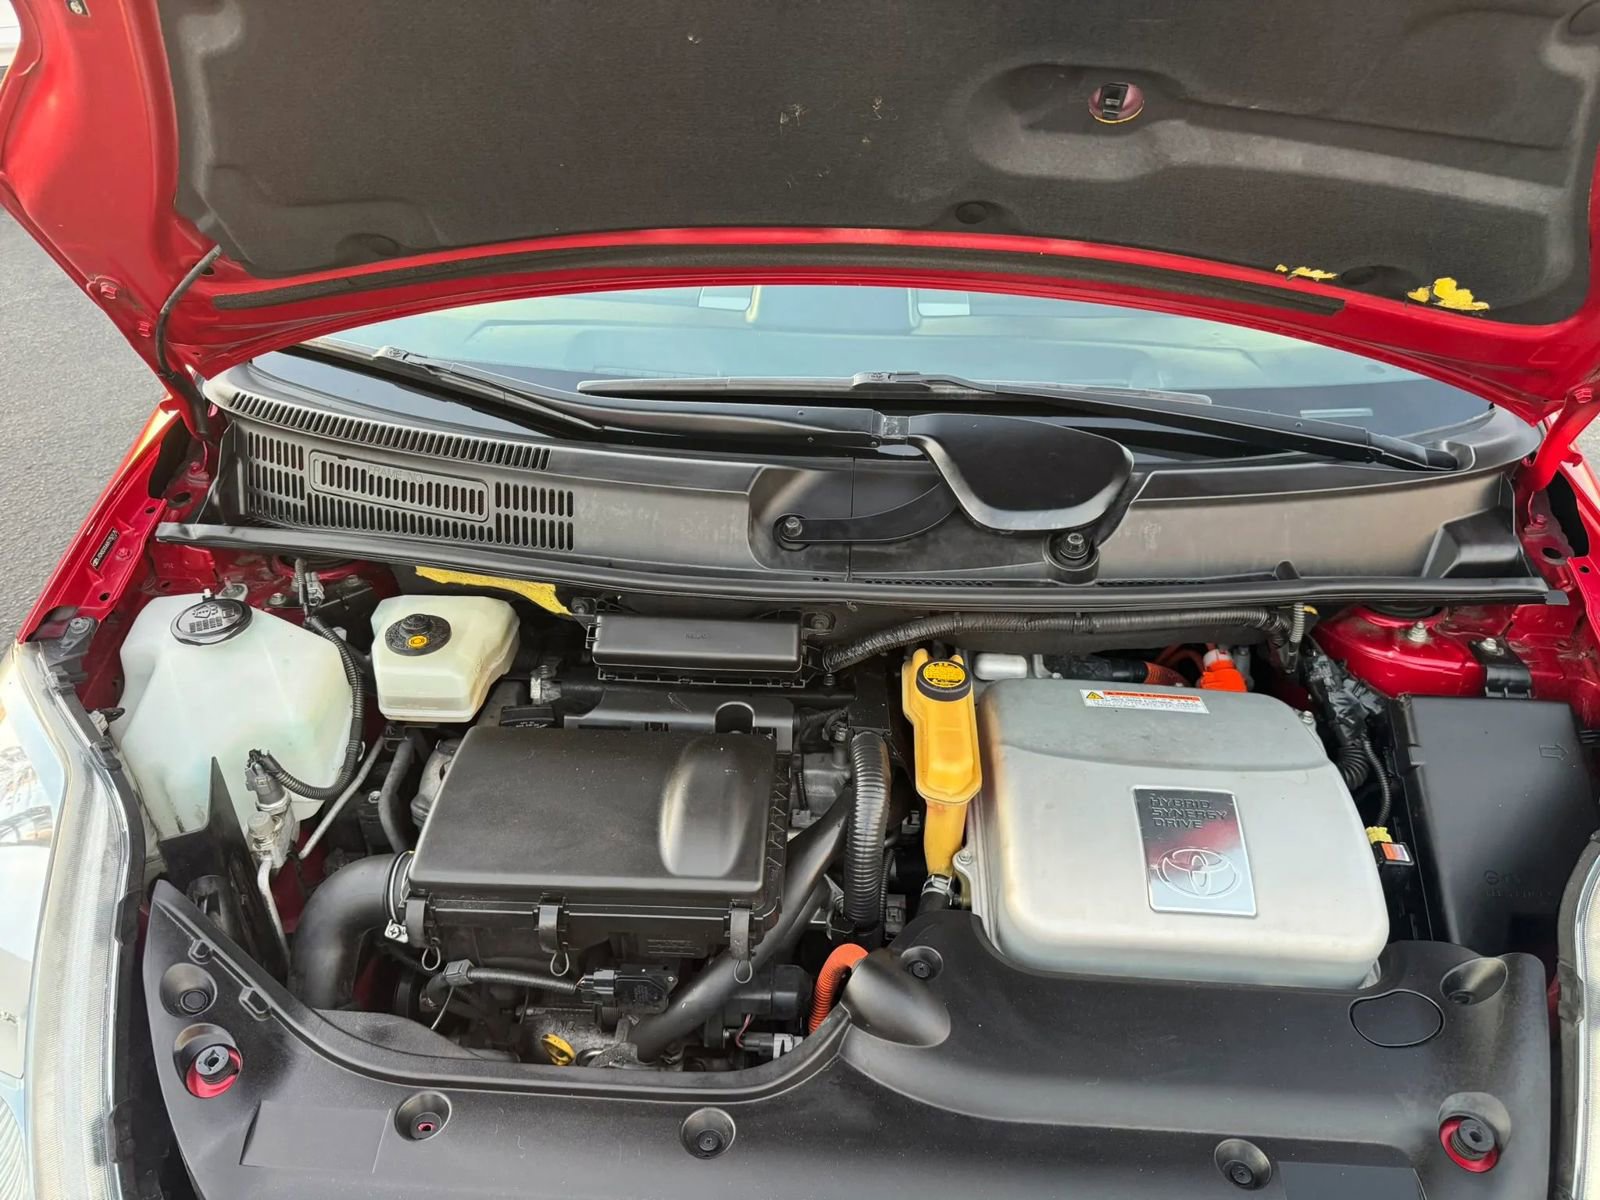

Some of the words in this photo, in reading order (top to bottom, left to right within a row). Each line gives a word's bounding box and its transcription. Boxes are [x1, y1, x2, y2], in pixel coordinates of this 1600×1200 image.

[1150, 794, 1211, 809] HYBRID
[1151, 807, 1228, 820] SYNERGY
[1151, 817, 1203, 829] DRIVE
